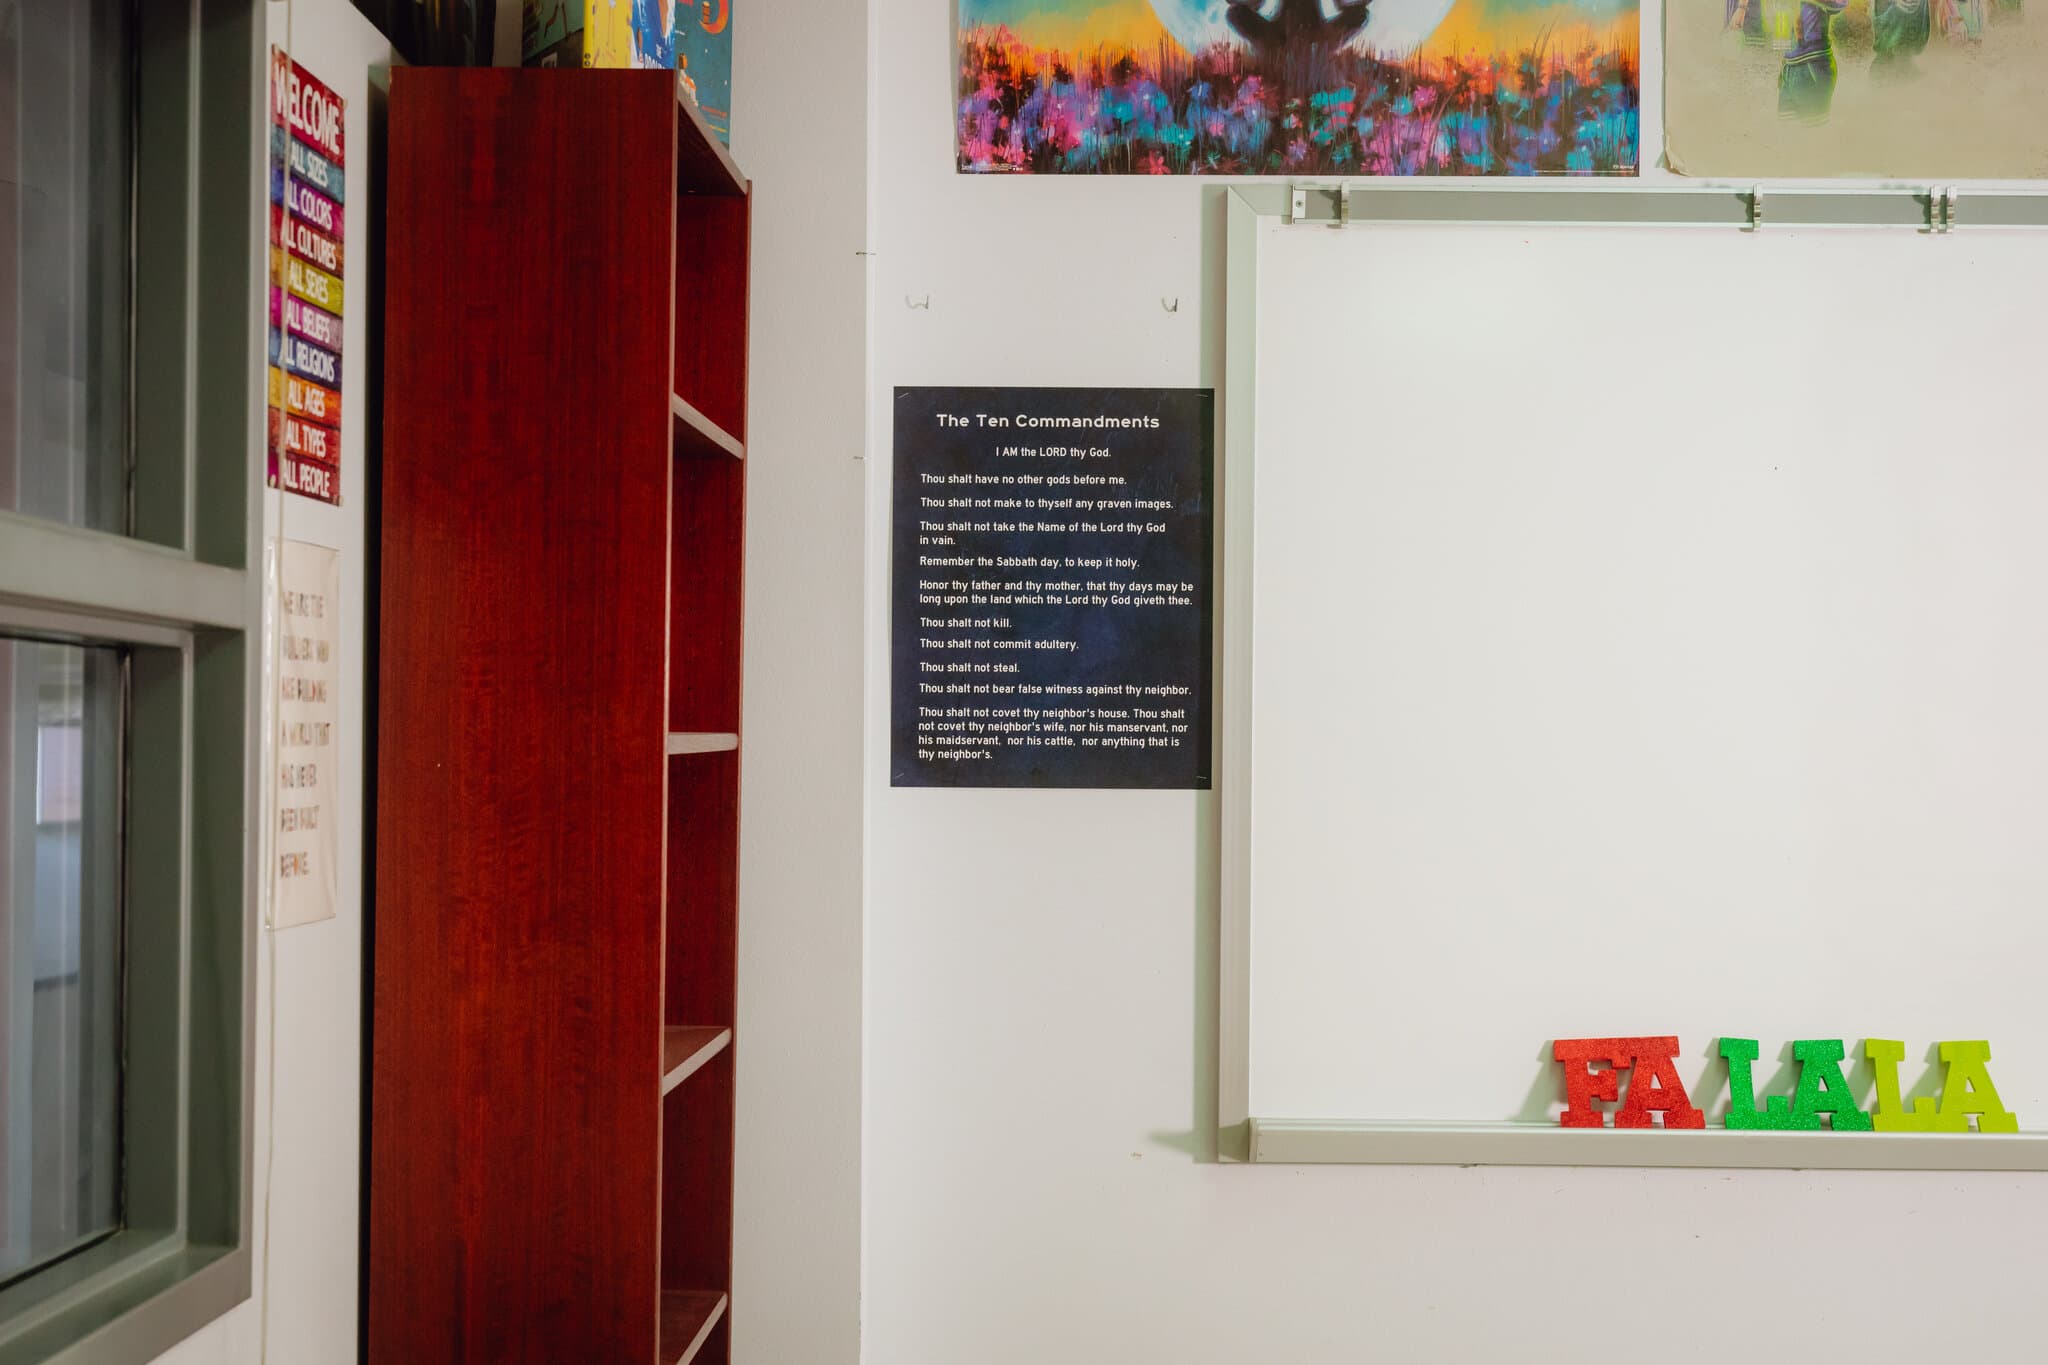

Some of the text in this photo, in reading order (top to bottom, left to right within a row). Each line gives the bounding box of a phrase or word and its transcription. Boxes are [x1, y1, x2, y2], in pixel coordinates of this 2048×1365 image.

[275, 62, 340, 155] WELCOME
[289, 141, 328, 188] ALL SIZES
[300, 188, 333, 231] COLORS
[297, 225, 336, 270] CULTURES
[289, 260, 304, 293] ALL
[287, 299, 331, 344] ALL BELIEFS
[296, 341, 336, 382] RELIGIONS
[288, 380, 325, 418] ALL AGES
[936, 414, 1160, 428] The Ten Commandments
[286, 419, 327, 459] ALL TYPES
[996, 446, 1112, 460] I AM the LORD thy God.
[300, 463, 331, 498] PEOPLE
[920, 473, 1127, 487] Thou shalt have no other gods before me.
[920, 497, 1174, 511] Thou shalt not make to thyself any graven images.
[920, 520, 1166, 535] Thou shalt not take the Name of the Lord thy God
[919, 534, 956, 545] in vain.
[920, 556, 975, 566] Remember
[977, 556, 994, 566] the
[996, 556, 1038, 567] Sabbath
[1064, 557, 1075, 567] to
[1077, 557, 1102, 570] keep
[1105, 557, 1113, 567] it
[1115, 557, 1140, 570] holy.
[919, 580, 949, 591] Honor
[952, 580, 968, 593] thy
[971, 580, 1001, 590] father
[1004, 580, 1023, 590] and
[1025, 580, 1042, 593] thy
[1086, 581, 1106, 591] that
[1109, 581, 1126, 594] thy
[1128, 581, 1153, 594] days
[1156, 583, 1178, 594] may
[1181, 581, 1194, 592] be
[919, 593, 1192, 608] long upon the land which the Lord thy God giveth thee.
[920, 617, 1012, 628] Thou shalt not kill.
[920, 638, 1079, 652] Thou shalt not commit adultery.
[920, 662, 1020, 672] Thou shalt not steal.
[919, 682, 1192, 697] Thou shalt not bear false witness against thy neighbor.
[919, 706, 1185, 720] Thou shalt not covet thy neighbor's house. Thou shalt
[918, 721, 935, 731] not
[937, 721, 966, 731] covet
[968, 721, 985, 734] thy
[988, 721, 1041, 734] neighbor's
[1070, 724, 1087, 732] nor
[1089, 722, 1104, 732] his
[1171, 724, 1188, 733] nor
[918, 734, 934, 745] his
[1007, 738, 1024, 746] nor
[1026, 735, 1042, 746] his
[1082, 738, 1099, 746] nor
[1101, 736, 1145, 749] anything
[1148, 736, 1168, 746] that
[1171, 736, 1180, 747] is
[918, 748, 993, 761] thy neighbor's.
